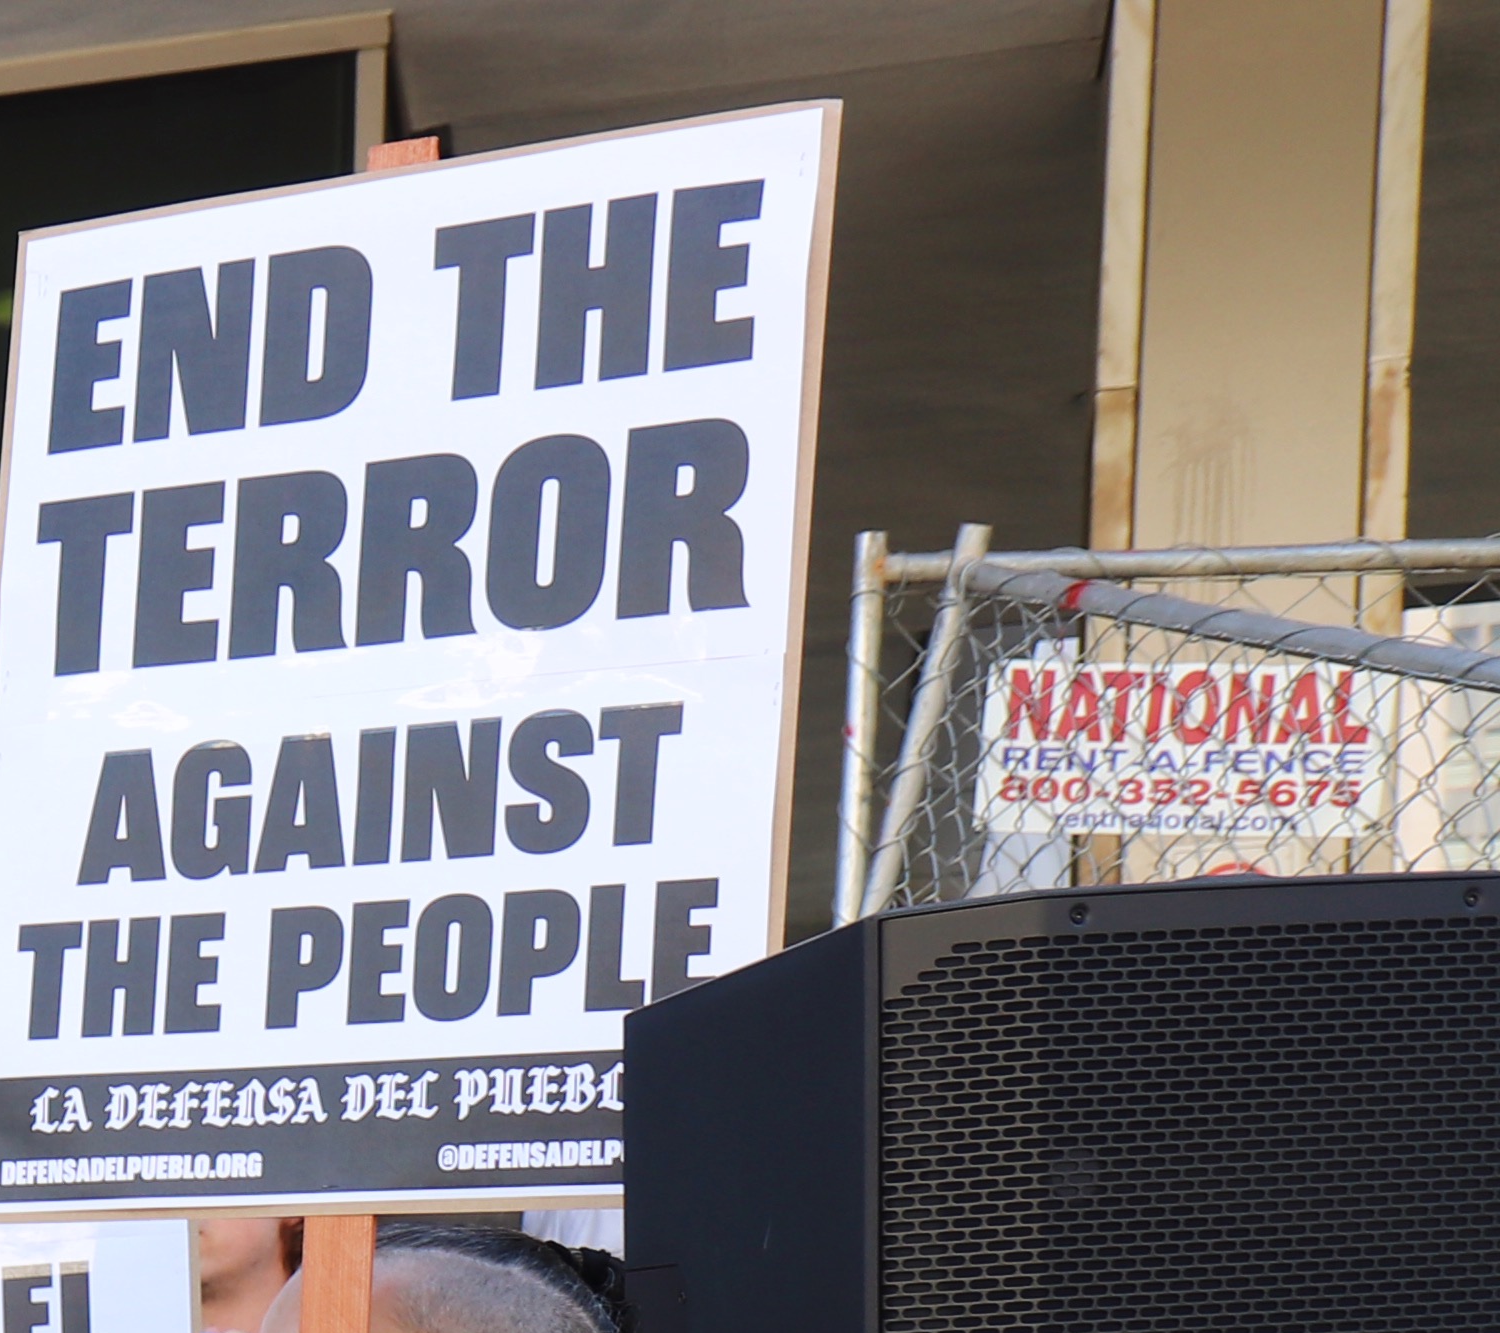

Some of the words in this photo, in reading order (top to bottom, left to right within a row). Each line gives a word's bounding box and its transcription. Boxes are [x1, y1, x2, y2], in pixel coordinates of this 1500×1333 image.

[46, 244, 374, 455] END
[435, 178, 765, 401] THE
[37, 416, 751, 678] TERROR
[1008, 668, 1370, 745] NATIONAL
[77, 700, 684, 886] AGAINST
[1000, 777, 1361, 808] 800-352-5675
[1002, 746, 1367, 774] RENT-A-FENCE
[19, 911, 226, 1041] THE
[266, 877, 719, 1030] PEOPLE
[31, 1087, 94, 1134] LA
[104, 1076, 327, 1132] DEFENSA
[340, 1070, 440, 1121] DEL
[453, 1062, 624, 1121] PUEBL
[1, 1152, 262, 1187] DEFENSADELPUEBLO.ORG
[437, 1139, 624, 1171] @DEFENSADELP
